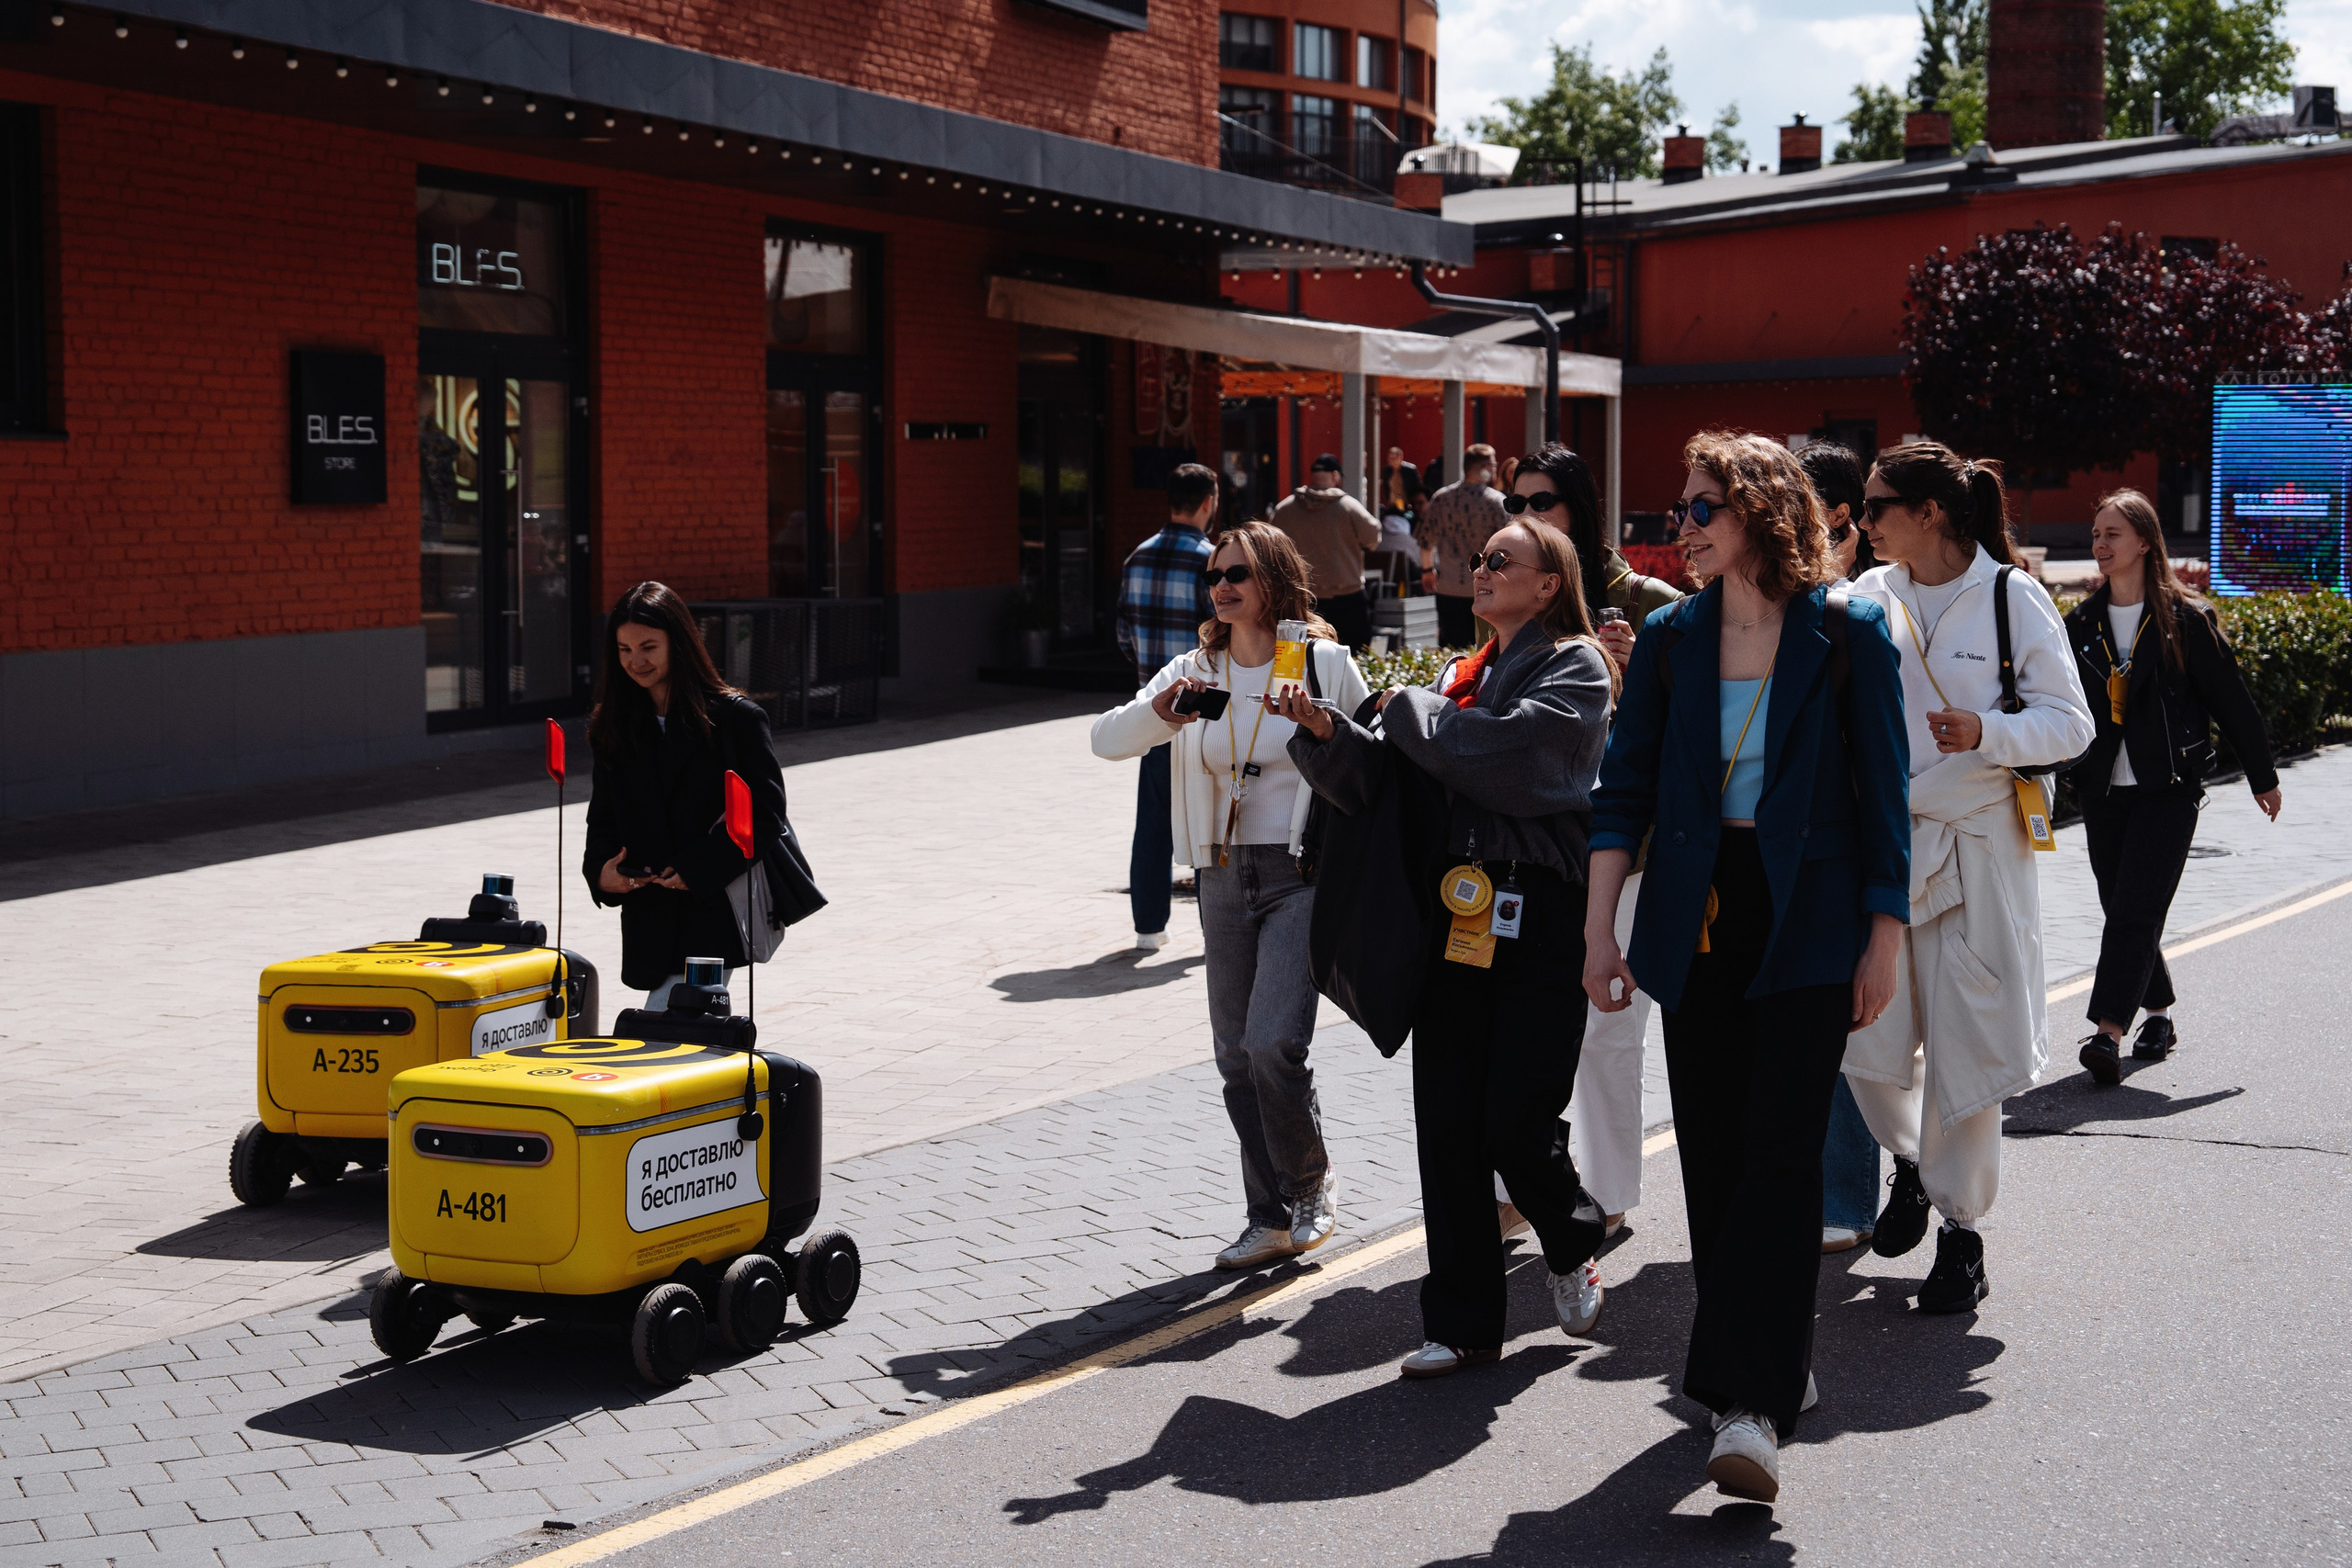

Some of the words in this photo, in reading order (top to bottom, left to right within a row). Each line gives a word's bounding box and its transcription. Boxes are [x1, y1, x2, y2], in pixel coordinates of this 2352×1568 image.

[323, 457, 356, 470] STORE
[1965, 652, 1986, 661] Niente
[1453, 928, 1480, 936] участник
[711, 995, 729, 1005] A-481
[490, 1018, 548, 1050] доставлю
[312, 1048, 379, 1074] A-235
[641, 1159, 651, 1180] я
[655, 1138, 743, 1181] доставлю
[641, 1171, 737, 1212] бесплатно
[436, 1189, 506, 1223] A-481
